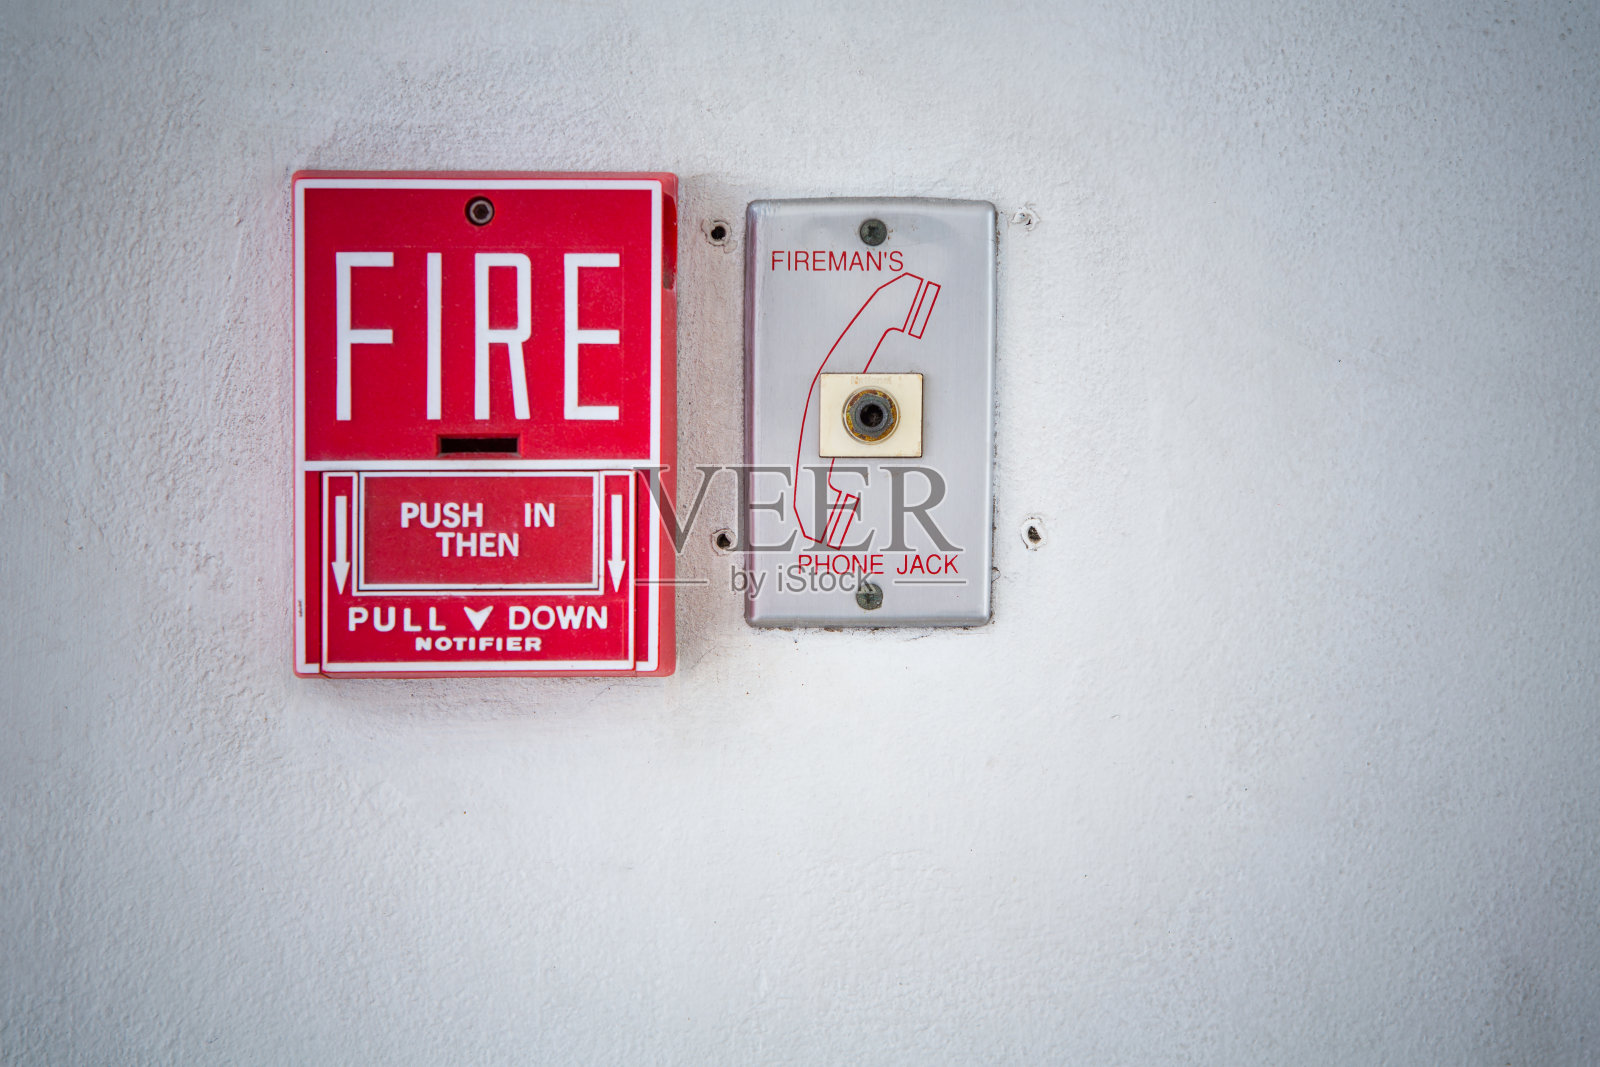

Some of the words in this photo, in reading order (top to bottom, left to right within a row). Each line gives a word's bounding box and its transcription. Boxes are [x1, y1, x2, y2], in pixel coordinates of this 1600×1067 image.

[771, 250, 904, 272] FIREMAN'S
[336, 252, 620, 420] FIRE
[401, 502, 483, 528] PUSH
[524, 502, 555, 528] IN
[436, 532, 519, 557] THEN
[798, 554, 884, 575] PHONE
[896, 554, 959, 575] JACK
[348, 606, 446, 632] PULL
[508, 605, 608, 630] DOWN
[415, 637, 542, 651] NOTIFIER
